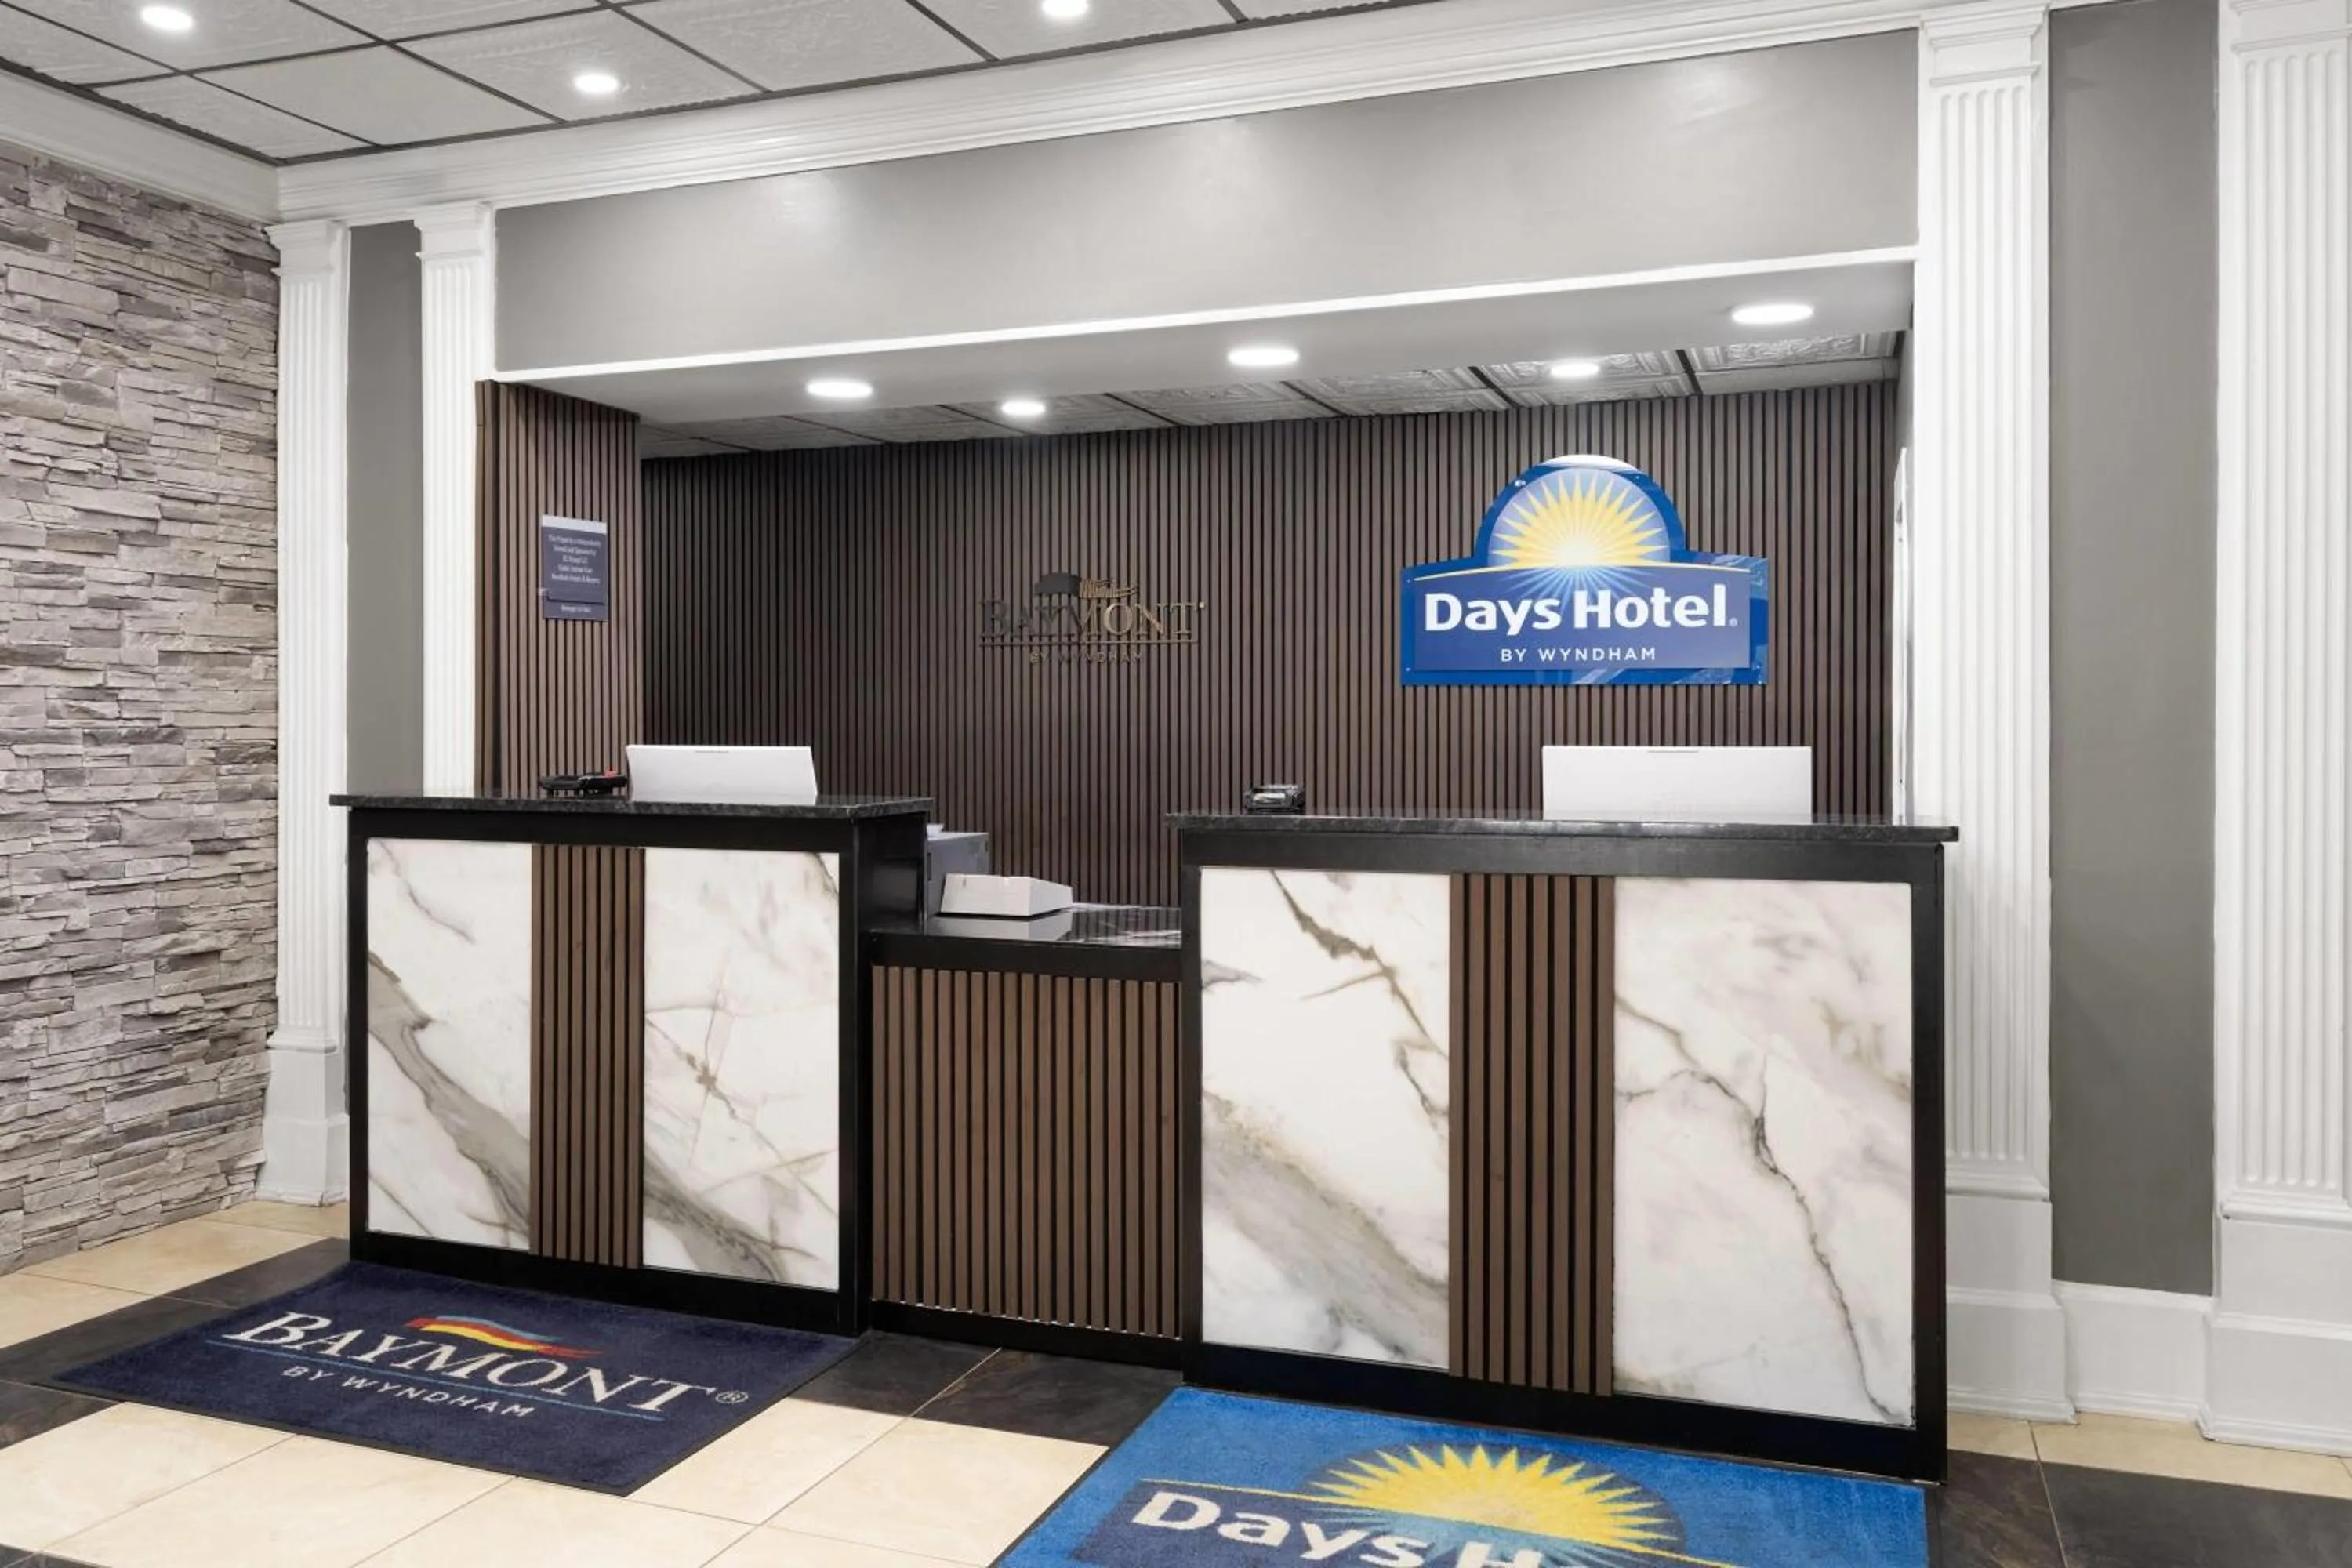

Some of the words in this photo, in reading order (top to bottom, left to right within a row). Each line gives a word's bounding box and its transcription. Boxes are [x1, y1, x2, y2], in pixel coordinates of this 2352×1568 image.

[1425, 593, 1562, 636] Days
[1501, 648, 1526, 662] BY
[1539, 648, 1656, 662] WYNDHAM
[282, 1365, 323, 1381] BY
[342, 1376, 535, 1417] WYNDHAM
[1131, 1490, 1433, 1568] Days
